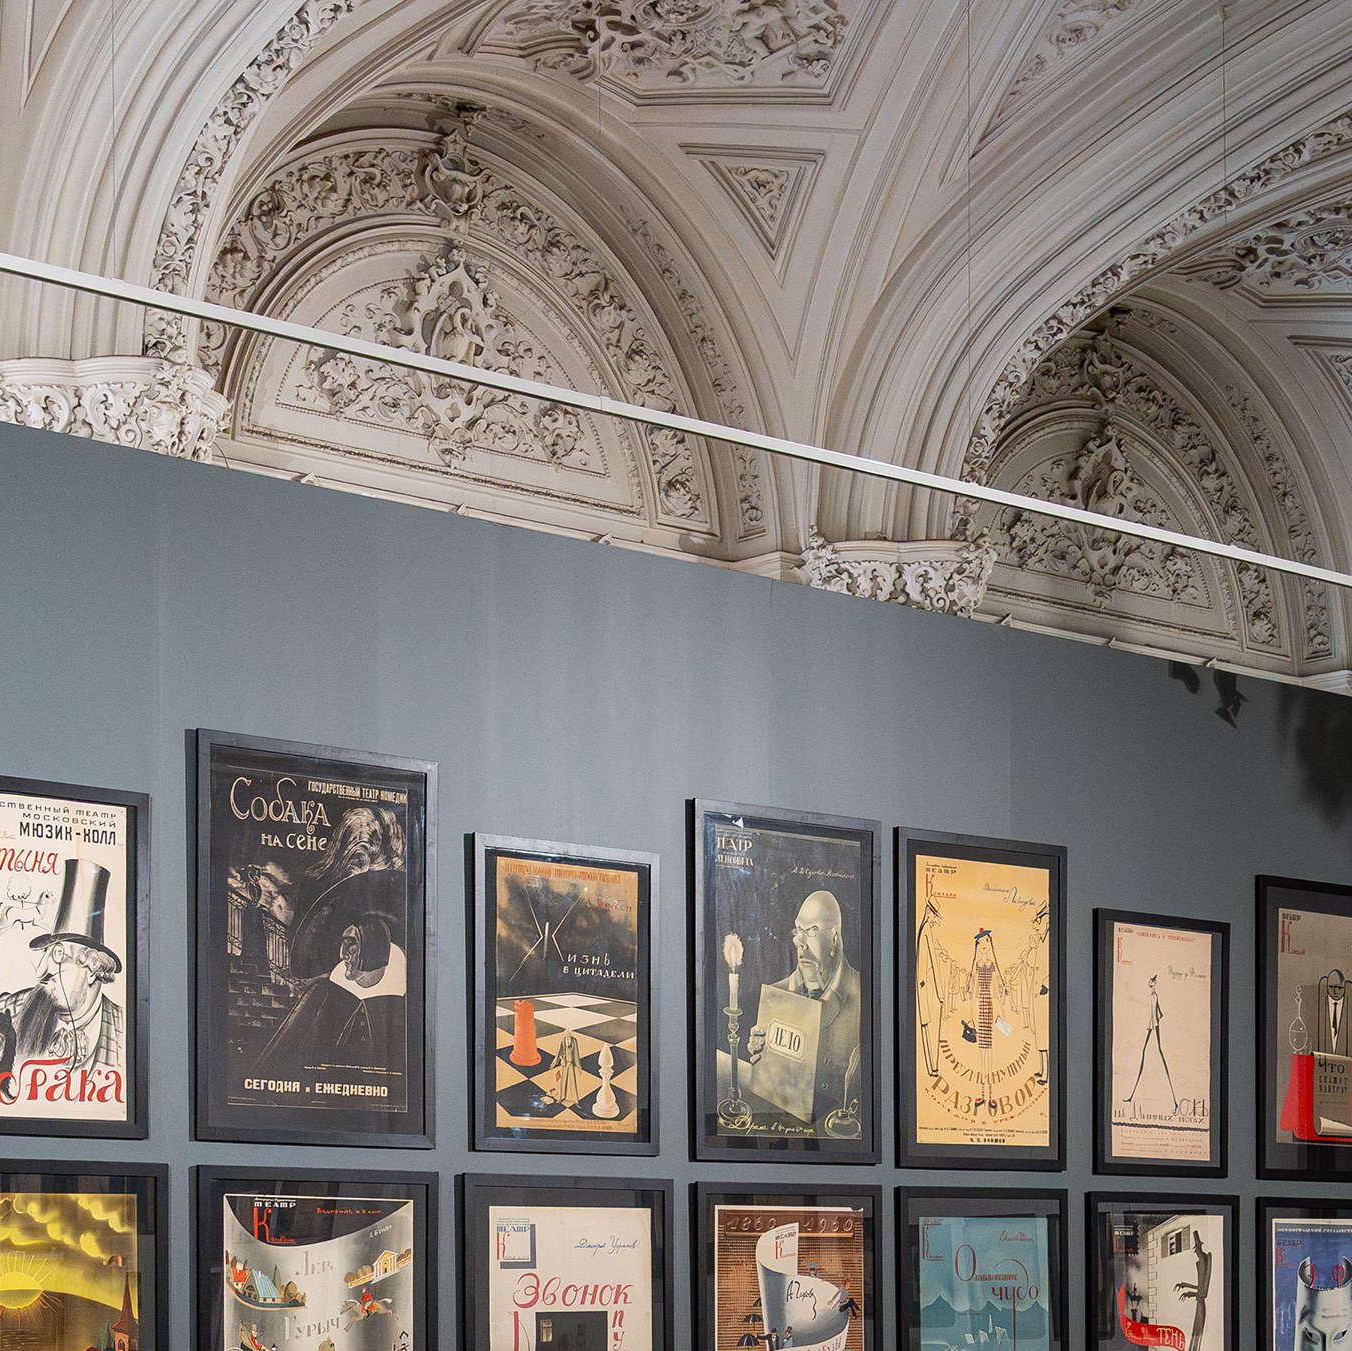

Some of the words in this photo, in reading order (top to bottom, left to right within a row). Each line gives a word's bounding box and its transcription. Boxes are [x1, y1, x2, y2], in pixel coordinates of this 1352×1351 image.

[307, 780, 361, 798] ГОСУДАРСТВЕННЫЙ
[361, 787, 379, 801] ТЕАТР
[22, 812, 117, 829] МОСКОВСКИЙ
[75, 809, 117, 820] ТЕАТР
[574, 966, 635, 980] ЦИТАДЕЛИ
[244, 1078, 301, 1093] СЕГОДНЯ
[315, 1082, 389, 1098] ЕЖЕДНЕВНО
[513, 1272, 634, 1308] Звонок
